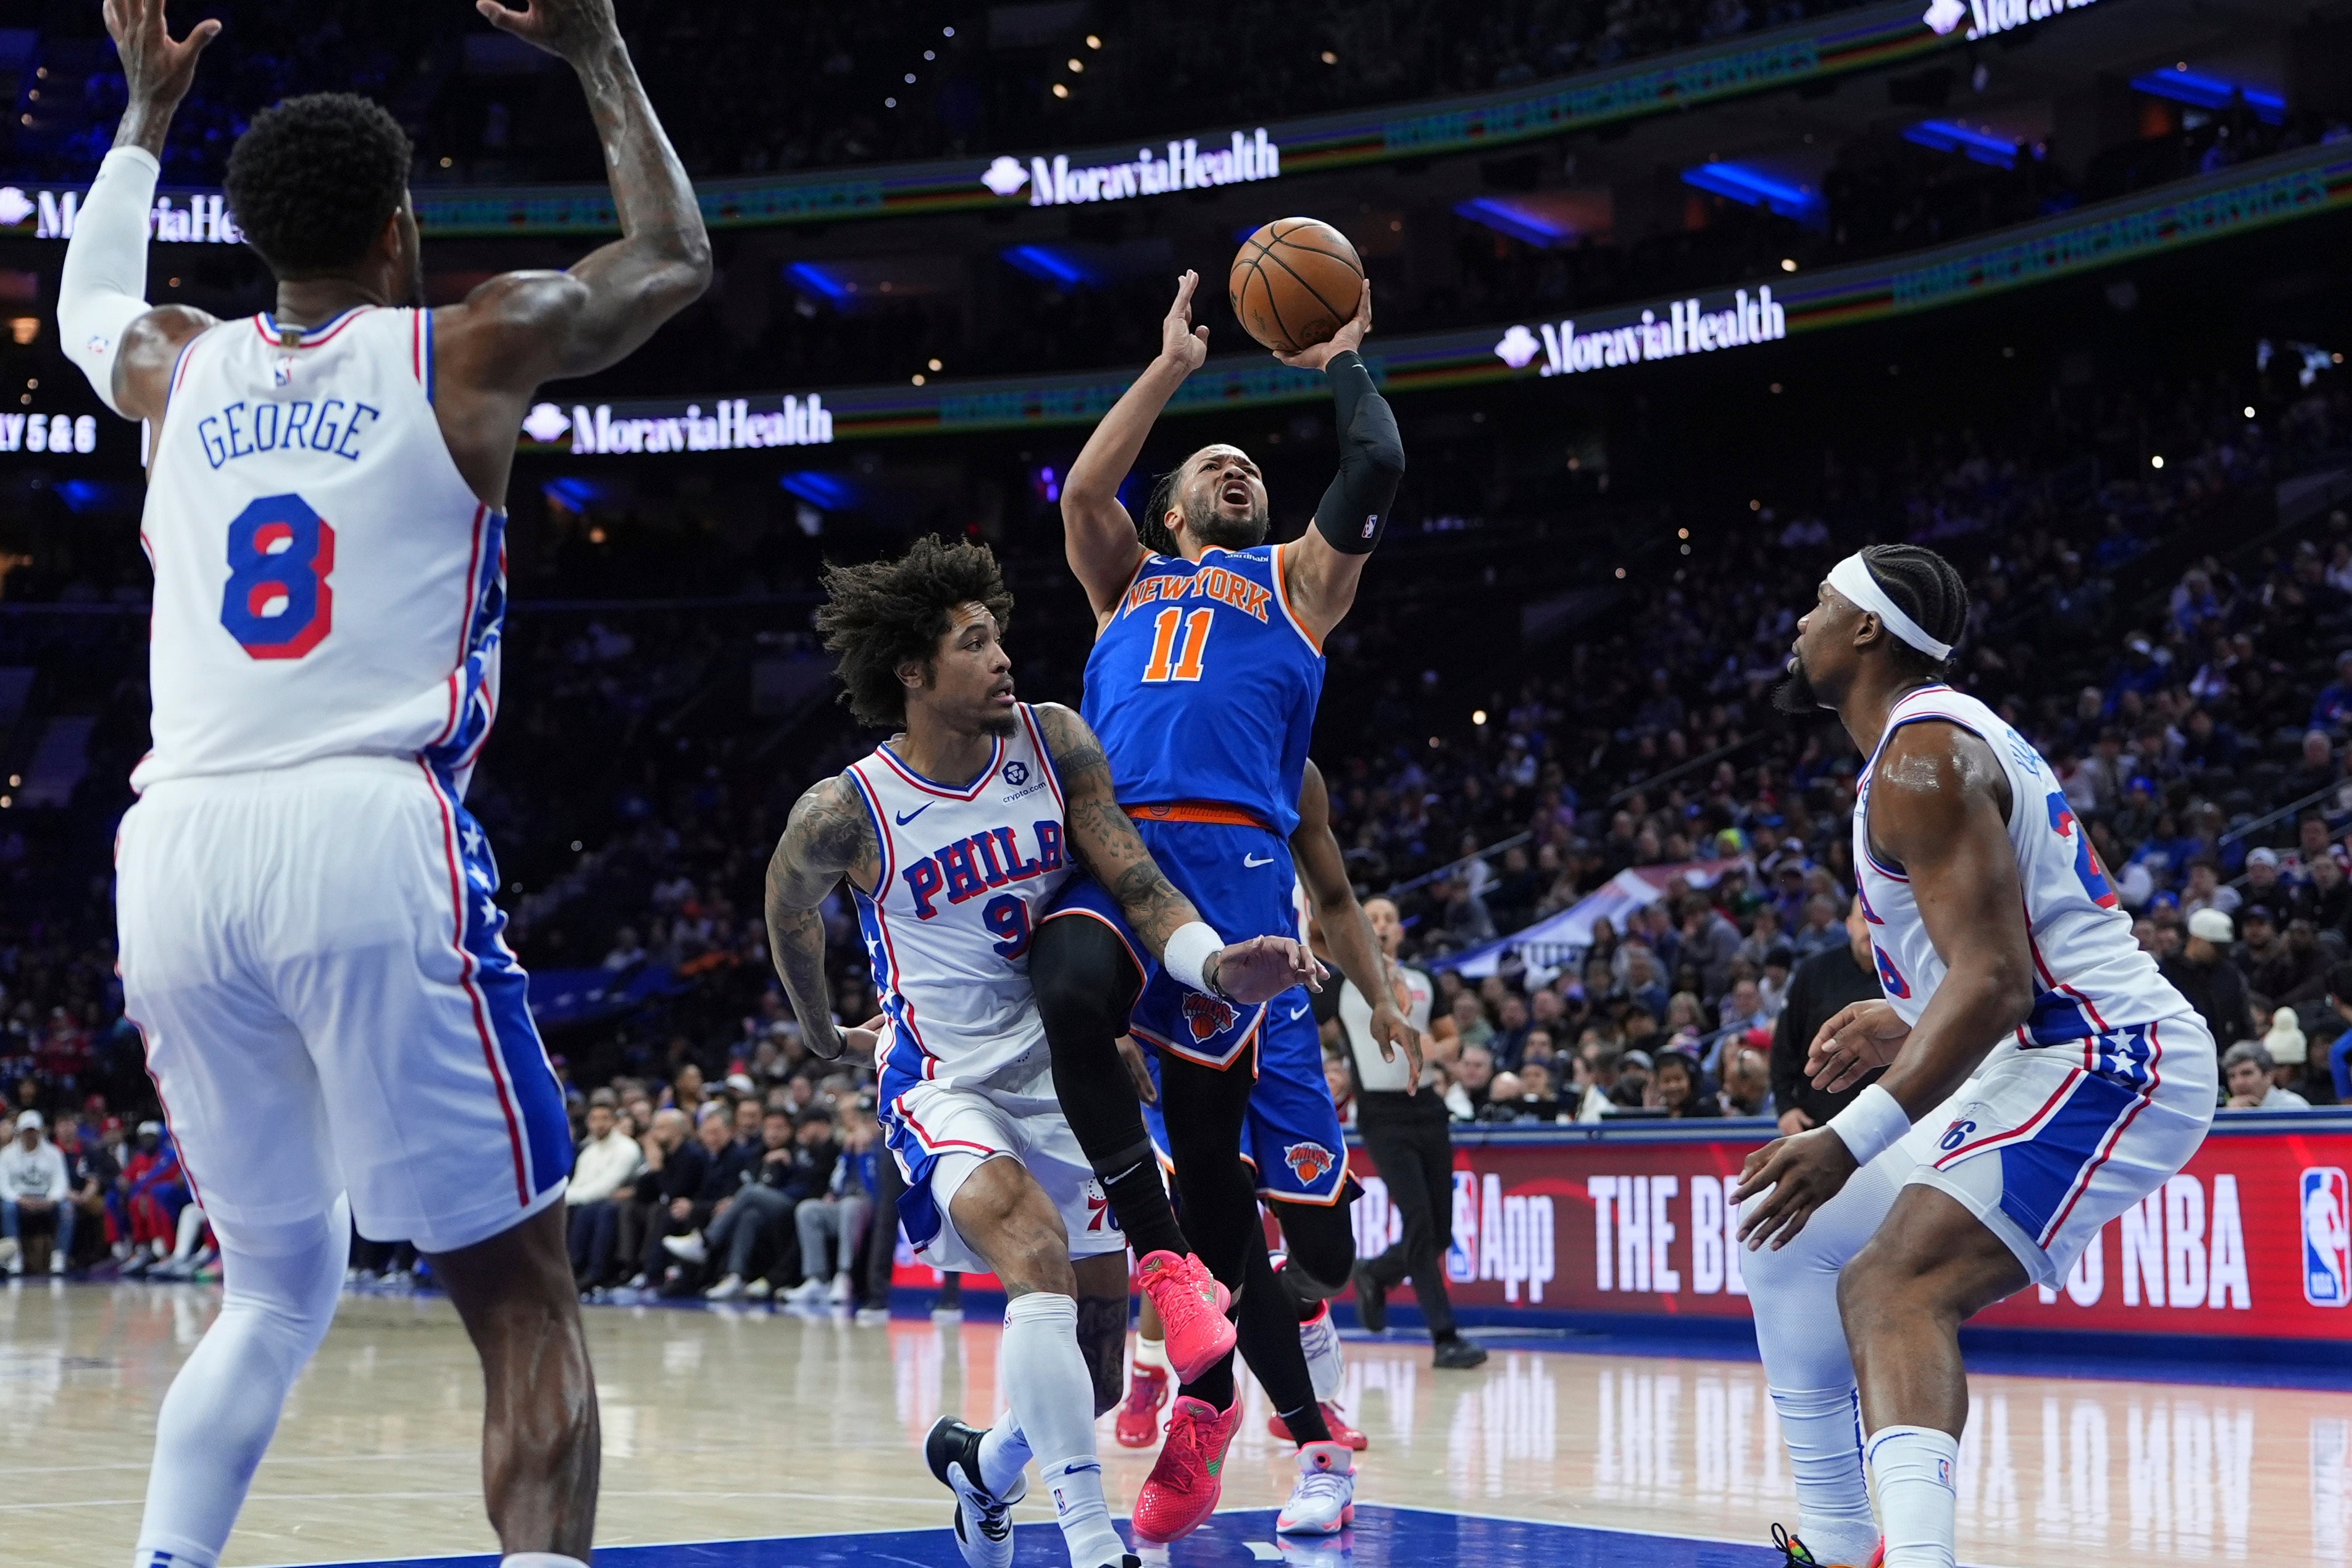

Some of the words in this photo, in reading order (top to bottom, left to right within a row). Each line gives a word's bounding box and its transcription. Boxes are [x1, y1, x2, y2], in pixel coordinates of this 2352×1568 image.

[1028, 127, 1280, 206] MoraviaHealth
[1539, 285, 1786, 377] MoraviaHealth
[198, 399, 380, 470] GEORGE
[570, 393, 833, 454] MoraviaHealth
[220, 493, 336, 660] 8
[1123, 575, 1193, 620] NEW
[1190, 566, 1272, 625] YORK
[1141, 606, 1215, 683] 11
[1003, 782, 1047, 804] crypto.com
[982, 893, 1032, 961] 9
[1482, 1173, 1554, 1304] App
[1587, 1175, 1680, 1293] THE
[2120, 1173, 2251, 1309] NBA
